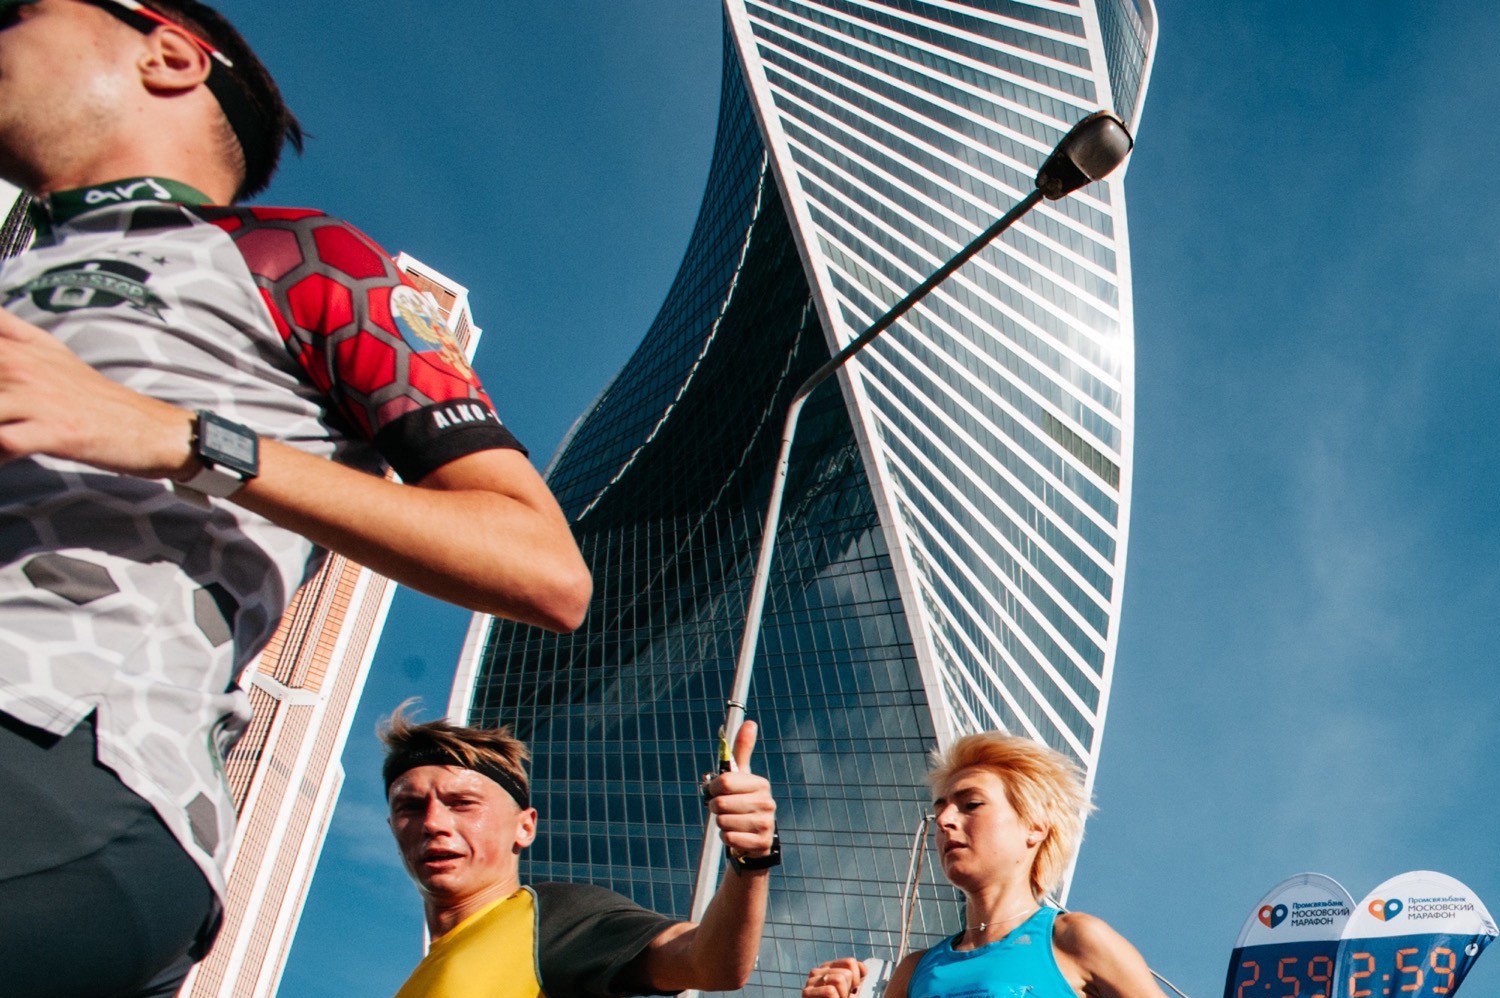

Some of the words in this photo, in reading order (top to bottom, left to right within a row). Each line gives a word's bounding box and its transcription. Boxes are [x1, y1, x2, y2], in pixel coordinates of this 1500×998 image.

[1407, 903, 1474, 912] МОСКОВСКИЙ
[1291, 907, 1350, 919] МОСКОВСКИЙ
[1407, 911, 1456, 920] МАРАФОН
[1291, 917, 1334, 927] МАРАФОН
[1349, 946, 1456, 998] 2:59
